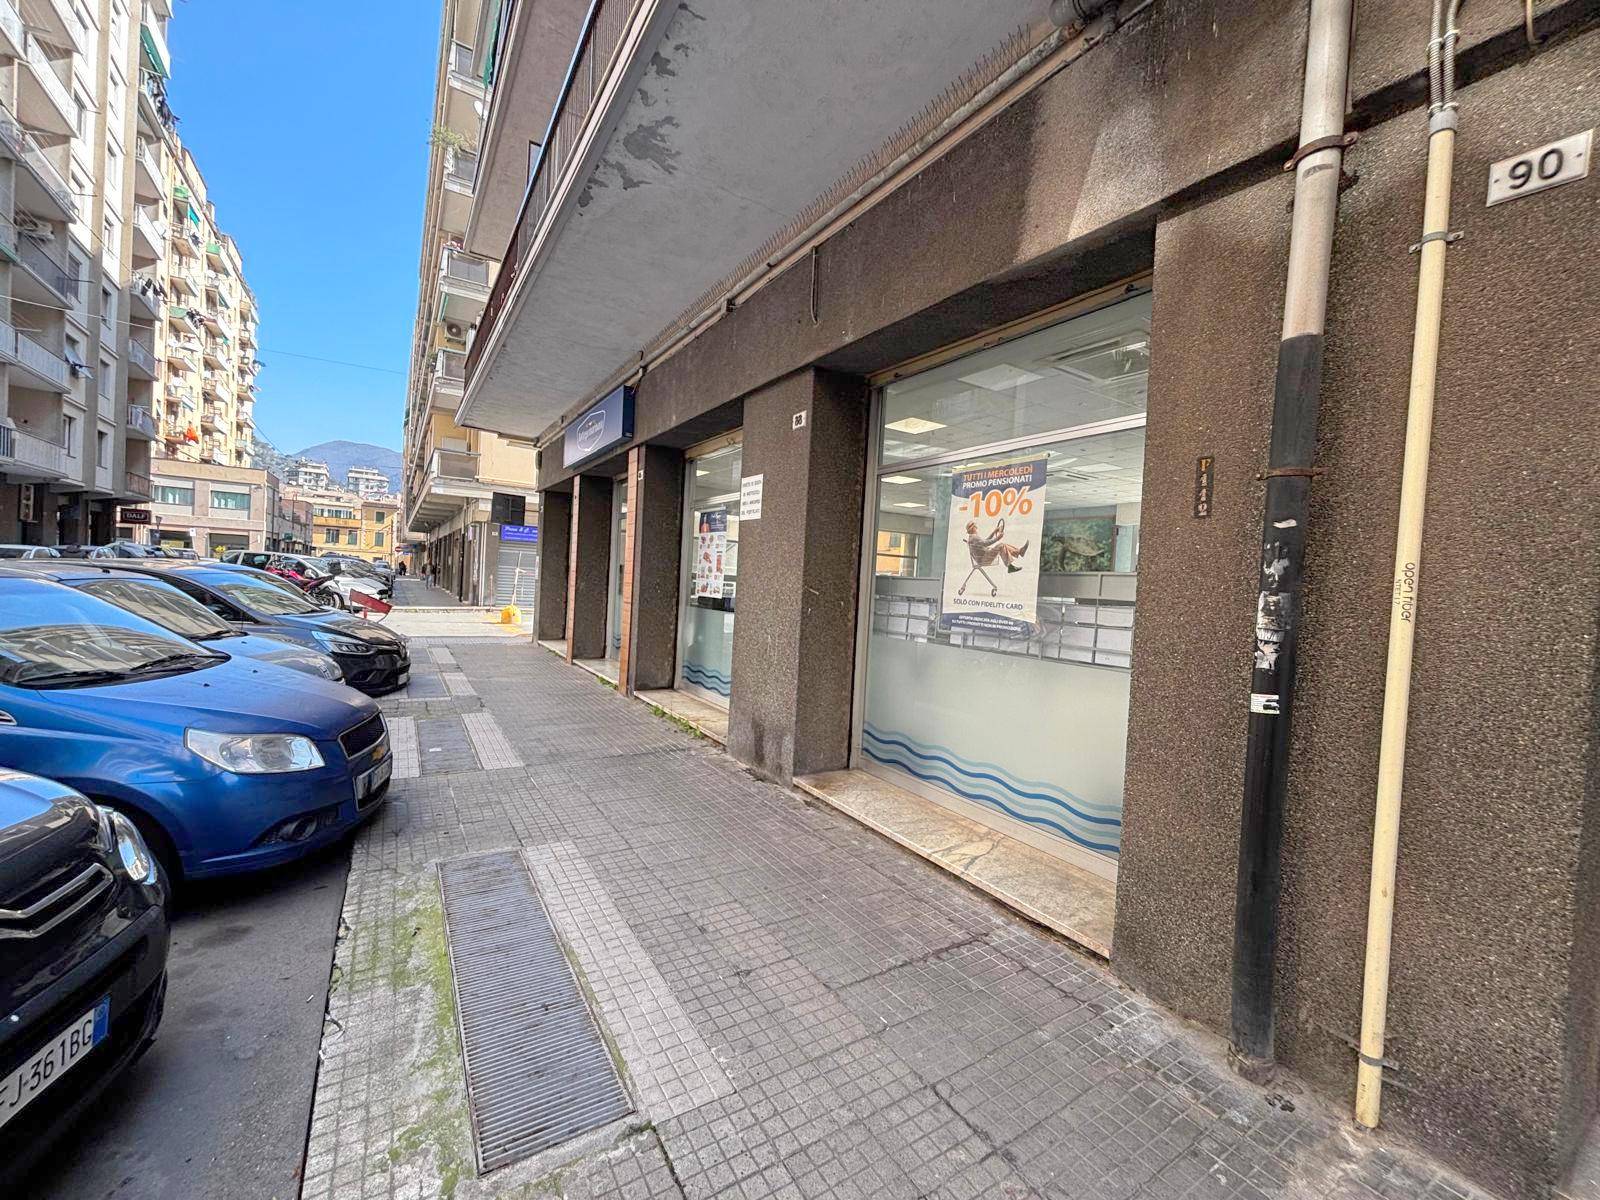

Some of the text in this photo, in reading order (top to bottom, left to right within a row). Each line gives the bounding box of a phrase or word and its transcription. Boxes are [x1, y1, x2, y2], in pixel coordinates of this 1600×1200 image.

[1508, 147, 1564, 190] 90
[962, 474, 1033, 489] PROMO PENSIONATI
[963, 472, 983, 482] TUTTI
[959, 485, 1034, 518] -10%
[953, 598, 1024, 611] SOLO CON FIDELITY CARD
[1400, 562, 1415, 623] open fiber
